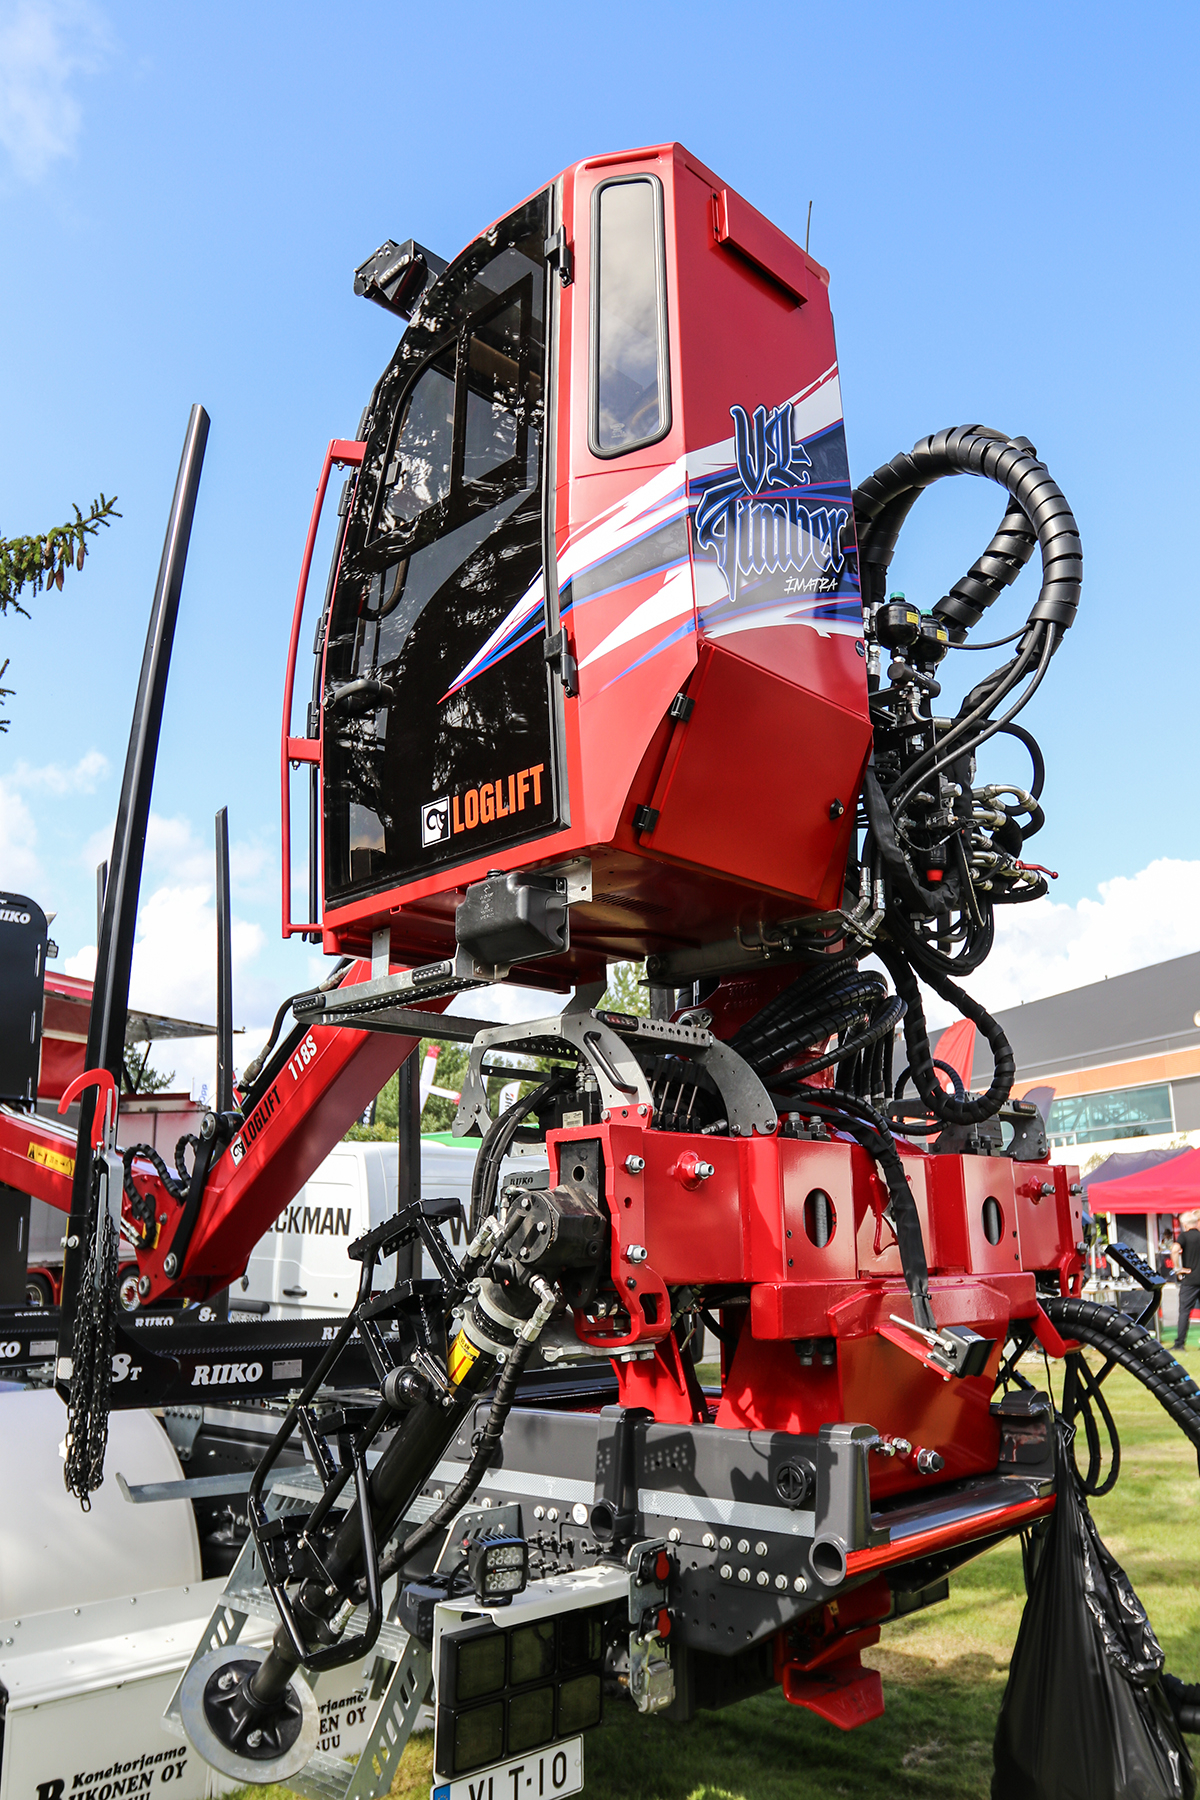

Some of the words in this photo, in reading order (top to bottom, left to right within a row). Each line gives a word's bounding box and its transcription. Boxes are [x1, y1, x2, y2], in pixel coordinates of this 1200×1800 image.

[453, 763, 544, 834] LOGLIFT
[288, 1034, 318, 1081] 118S
[242, 1085, 282, 1148] LOGLIFT
[268, 1206, 352, 1236] CKMAN
[191, 1362, 263, 1386] RIIKO
[346, 1705, 367, 1727] OY
[72, 1746, 187, 1790] Konekorjaamo
[160, 1760, 188, 1783] OY
